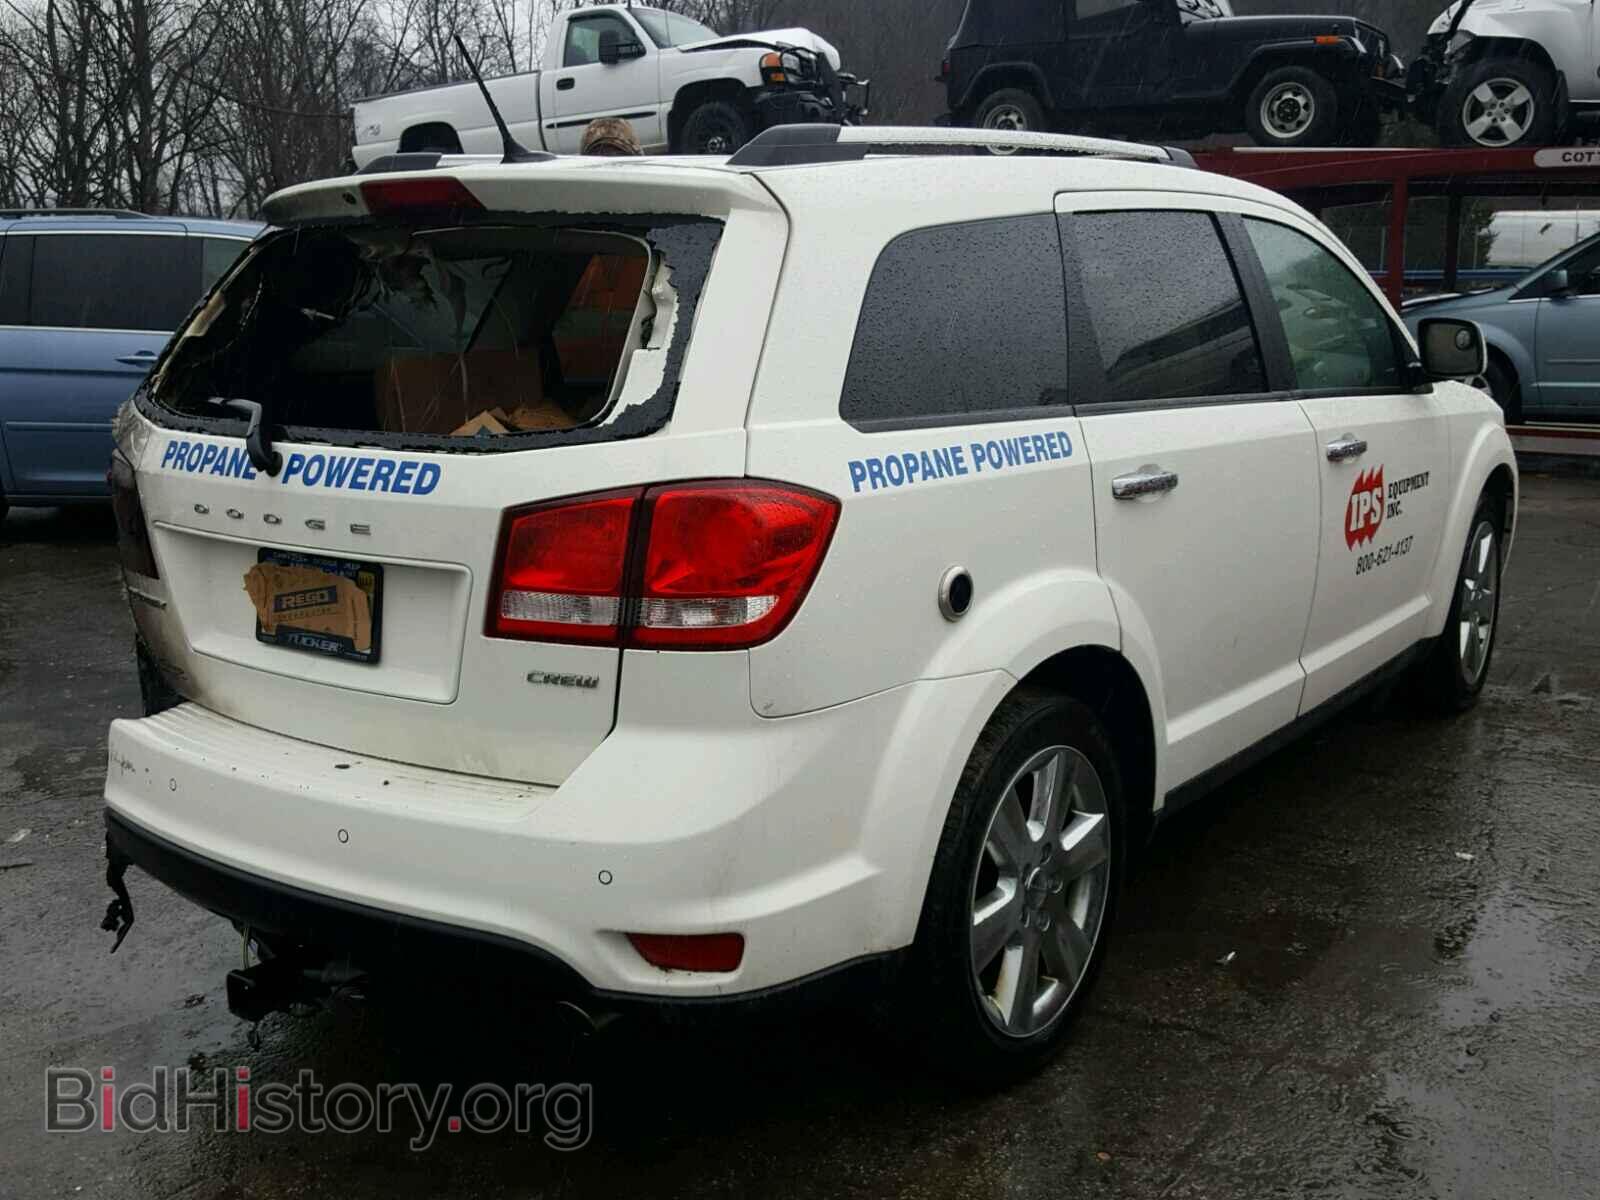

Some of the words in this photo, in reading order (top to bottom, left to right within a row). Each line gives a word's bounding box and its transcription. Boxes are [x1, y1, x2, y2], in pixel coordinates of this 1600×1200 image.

[161, 440, 257, 480] PROPANE
[282, 453, 441, 495] POWERED
[848, 446, 968, 493] PROPANE
[970, 431, 1073, 472] POWERED
[1388, 471, 1429, 499] EQUIPMENT
[194, 503, 371, 536] DODGE
[1350, 487, 1383, 532] IPS
[527, 670, 599, 689] CREW
